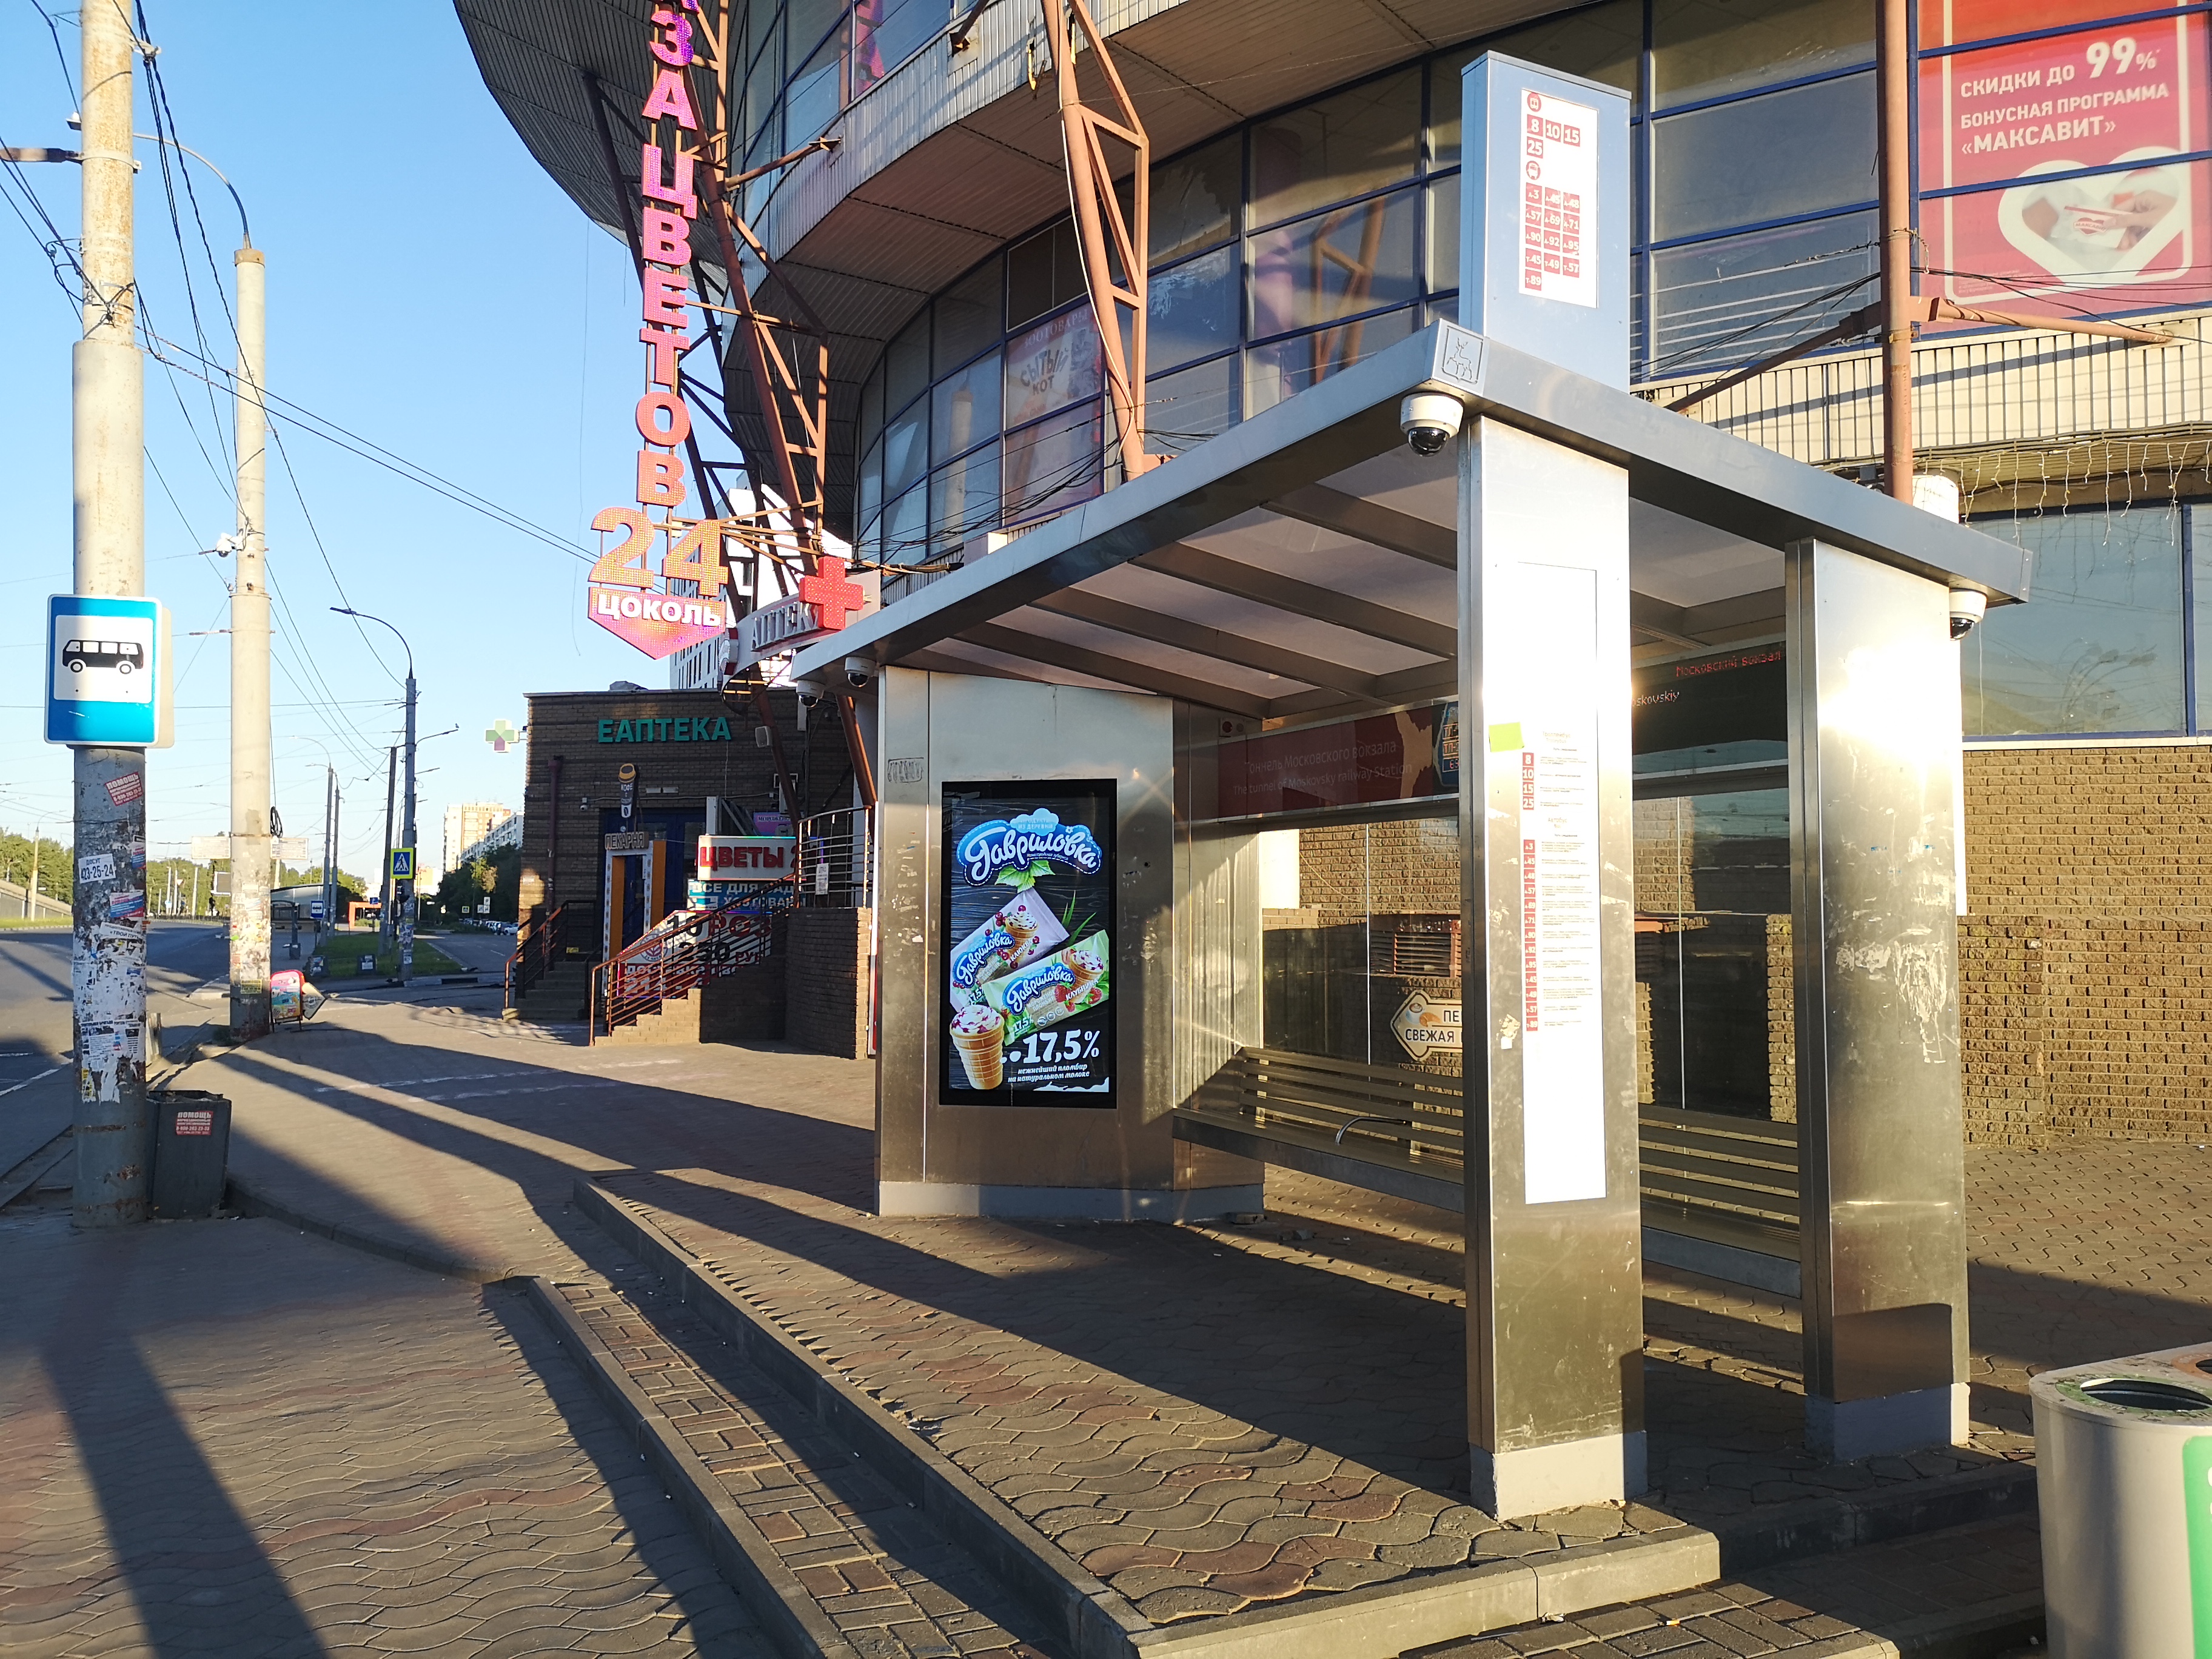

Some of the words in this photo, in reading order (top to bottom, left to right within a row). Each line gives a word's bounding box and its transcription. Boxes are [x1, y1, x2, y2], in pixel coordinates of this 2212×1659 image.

[642, 0, 700, 131] ЗА
[1960, 70, 2041, 98] СКИДКИ
[2046, 64, 2075, 87] ДО
[1960, 101, 2053, 129] БОНУСНАЯ
[2057, 82, 2169, 115] ПРОГРАММА
[1531, 118, 1540, 133] 8
[1546, 123, 1560, 139] 10
[1564, 128, 1580, 144] 15
[1961, 115, 2116, 154] «МАКСАВИТ»
[1527, 139, 1543, 156] 25
[1021, 347, 1069, 387] СЫТЫЙ
[1033, 375, 1054, 395] КОТ
[588, 507, 728, 597] 24
[598, 594, 721, 627] ЦОКОЛЬ
[751, 602, 819, 651] АПТЕК
[1676, 655, 1737, 677] Московский
[1741, 651, 1781, 667] вокзал
[1632, 689, 1680, 707] oskovskiy
[598, 717, 731, 743] ЕАПТЕКА
[1285, 748, 1350, 768] Московского
[1353, 741, 1396, 758] вокзала
[1525, 754, 1532, 765] 8
[106, 774, 139, 789] ПОМОЩЬ
[1249, 781, 1275, 793] tunnel
[1278, 779, 1287, 790] of
[1289, 773, 1335, 788] Moskovsky
[1338, 768, 1373, 783] railway
[1523, 769, 1534, 779] 10
[1523, 783, 1534, 794] 15
[1523, 798, 1534, 808] 25
[605, 832, 645, 848] ПЕКАРНЯ
[700, 846, 783, 871] ЦВЕТЫ
[965, 826, 1097, 881] Гавриловка
[693, 883, 722, 893] ВСЕ
[727, 883, 758, 894] ДЛЯ
[957, 933, 1012, 985] Гавриловка
[1007, 967, 1073, 1013] Гавриловка
[1444, 1010, 1463, 1022] ПЕ
[1406, 1028, 1454, 1043] СВЕЖАЯ
[1017, 1074, 1064, 1084] натуральном
[1065, 1071, 1090, 1079] молоке
[1018, 1066, 1056, 1074] нежнейший
[1058, 1063, 1087, 1073] пломбир
